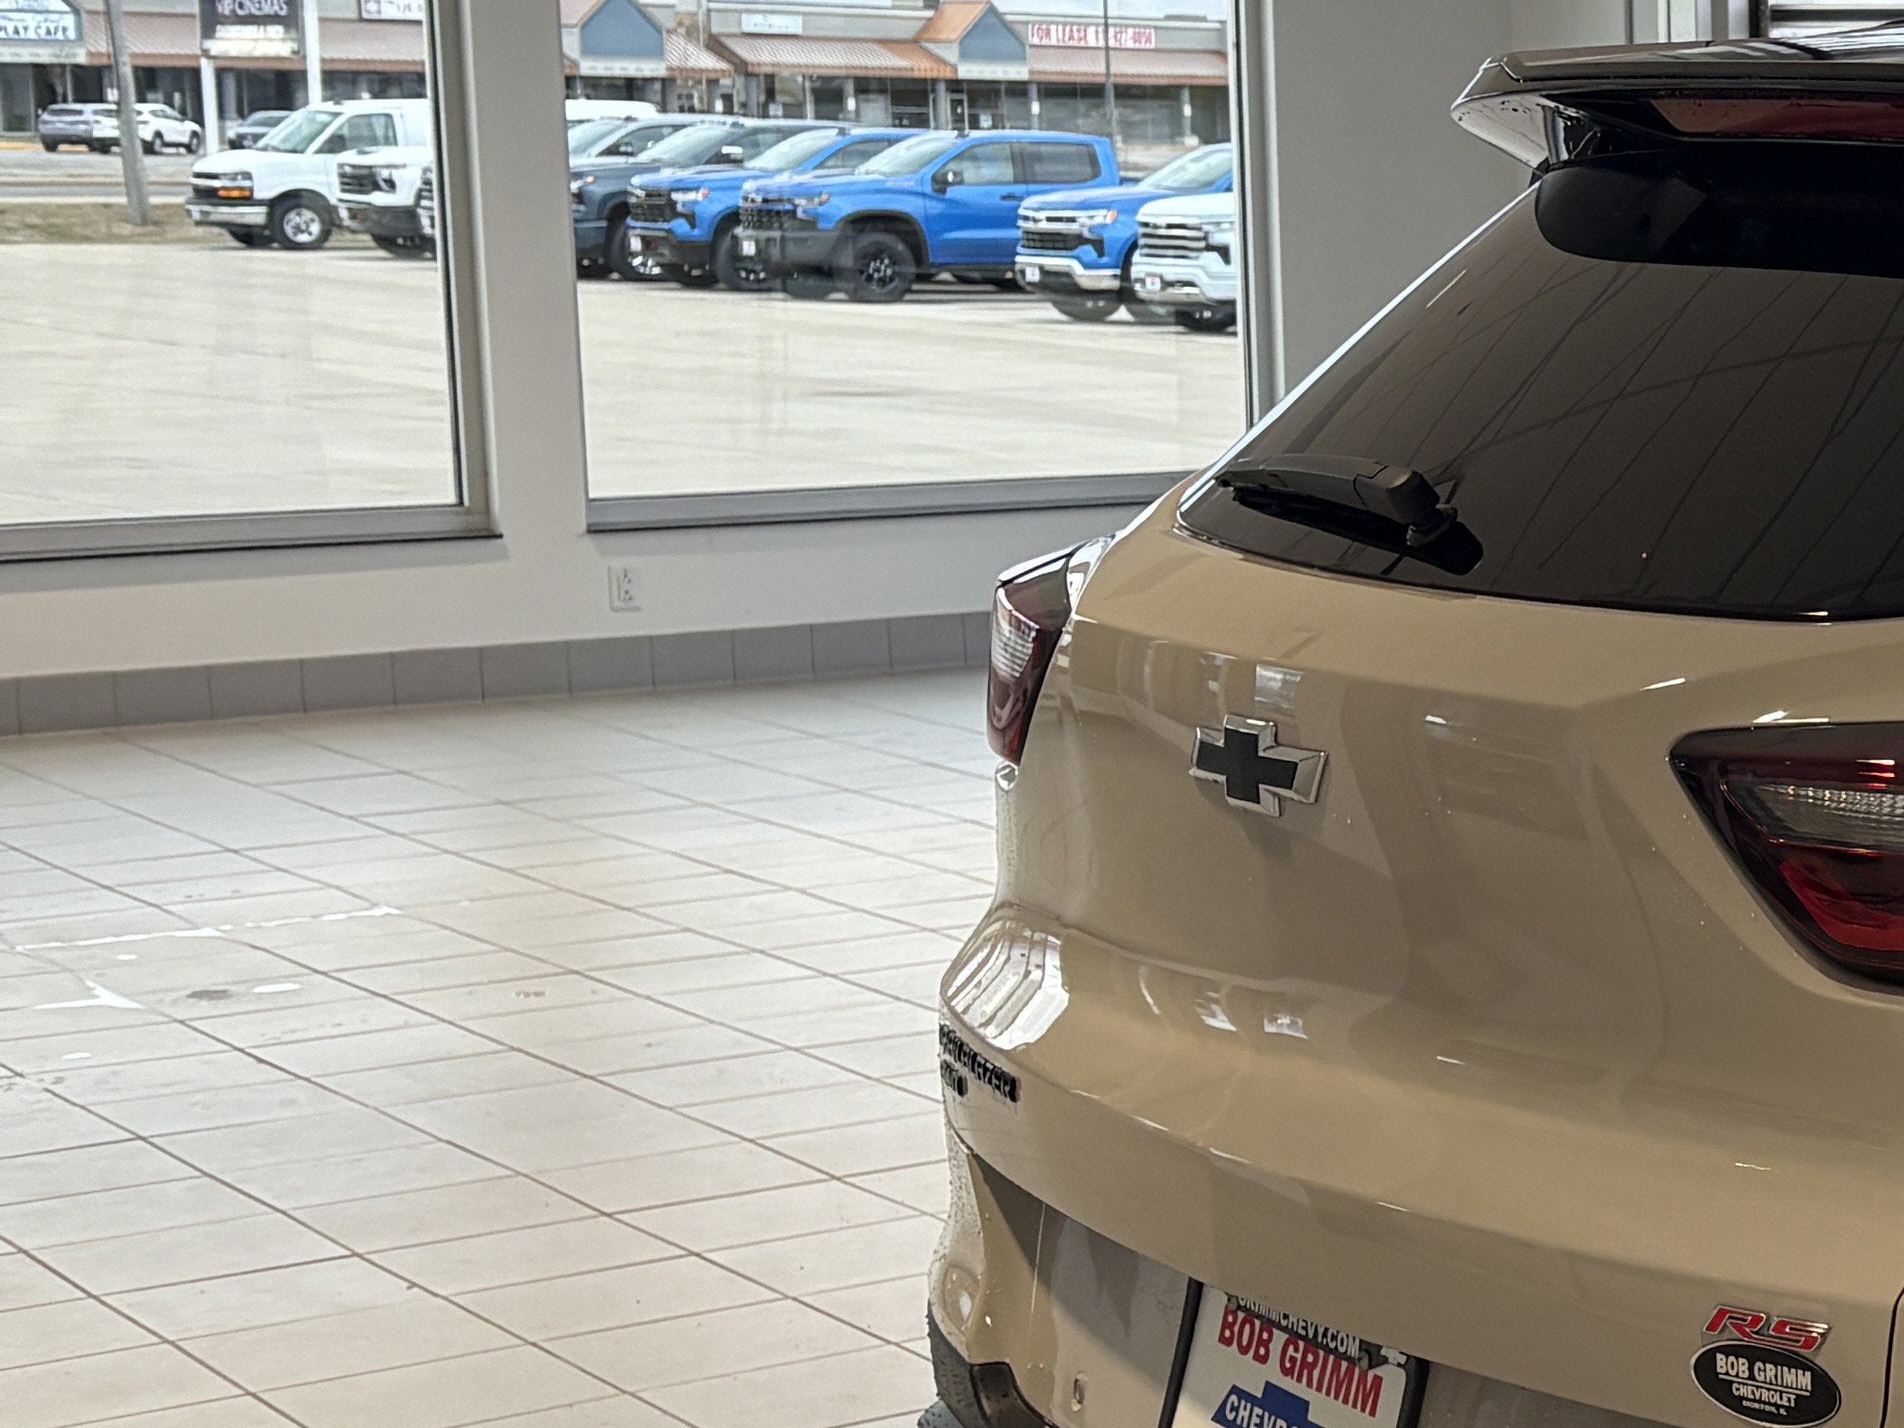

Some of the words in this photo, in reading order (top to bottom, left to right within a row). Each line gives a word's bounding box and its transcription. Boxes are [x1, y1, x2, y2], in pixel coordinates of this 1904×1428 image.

[1704, 1306, 1830, 1351] RS
[1218, 1306, 1274, 1365] BOB
[1279, 1338, 1384, 1418] GRIMM
[1715, 1352, 1749, 1378] BOB
[1754, 1361, 1812, 1391] GRIMM
[1731, 1383, 1797, 1408] CHEVROLET
